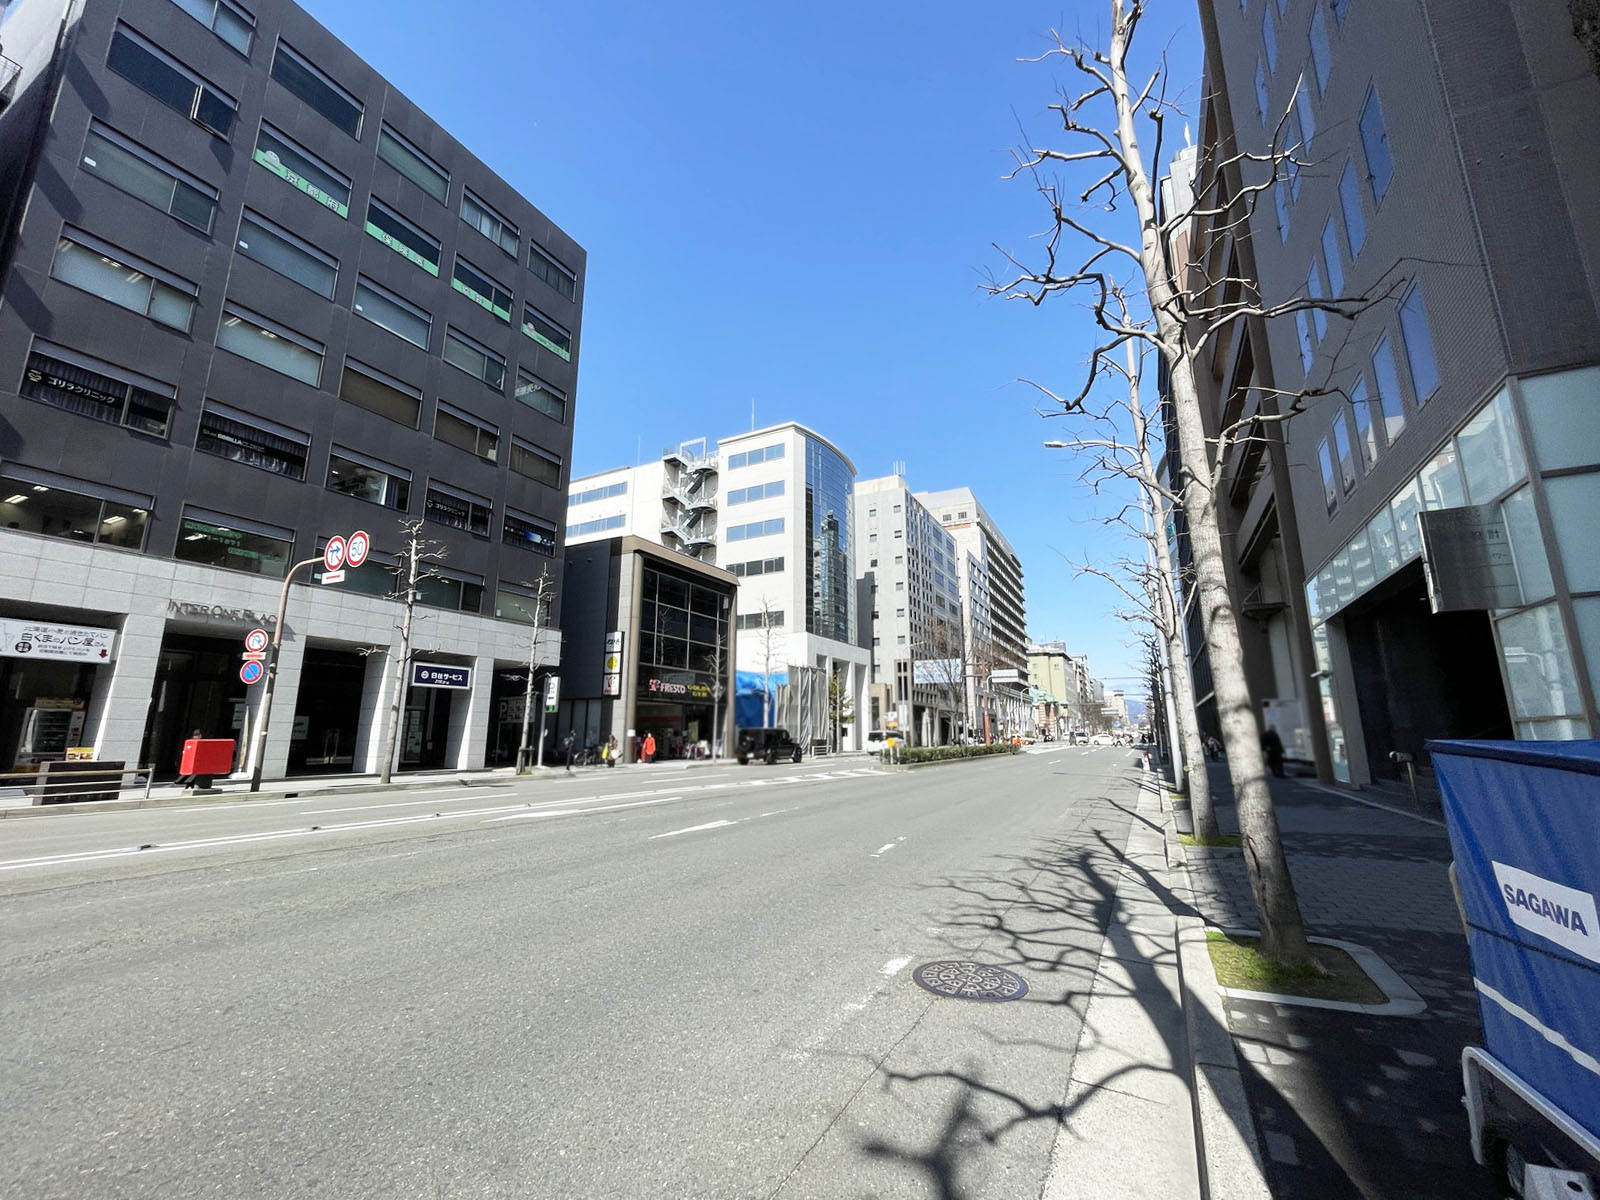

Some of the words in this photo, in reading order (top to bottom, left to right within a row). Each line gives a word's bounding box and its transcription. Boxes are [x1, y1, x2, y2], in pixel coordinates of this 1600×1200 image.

[48, 376, 115, 404] ゴリラクリニック
[351, 541, 364, 557] 50
[167, 598, 210, 615] INTER
[211, 605, 241, 620] ONE
[242, 608, 278, 624] PLAC
[21, 632, 107, 648] 白くまのパン屋さん
[1503, 883, 1588, 936] SAGAWA
